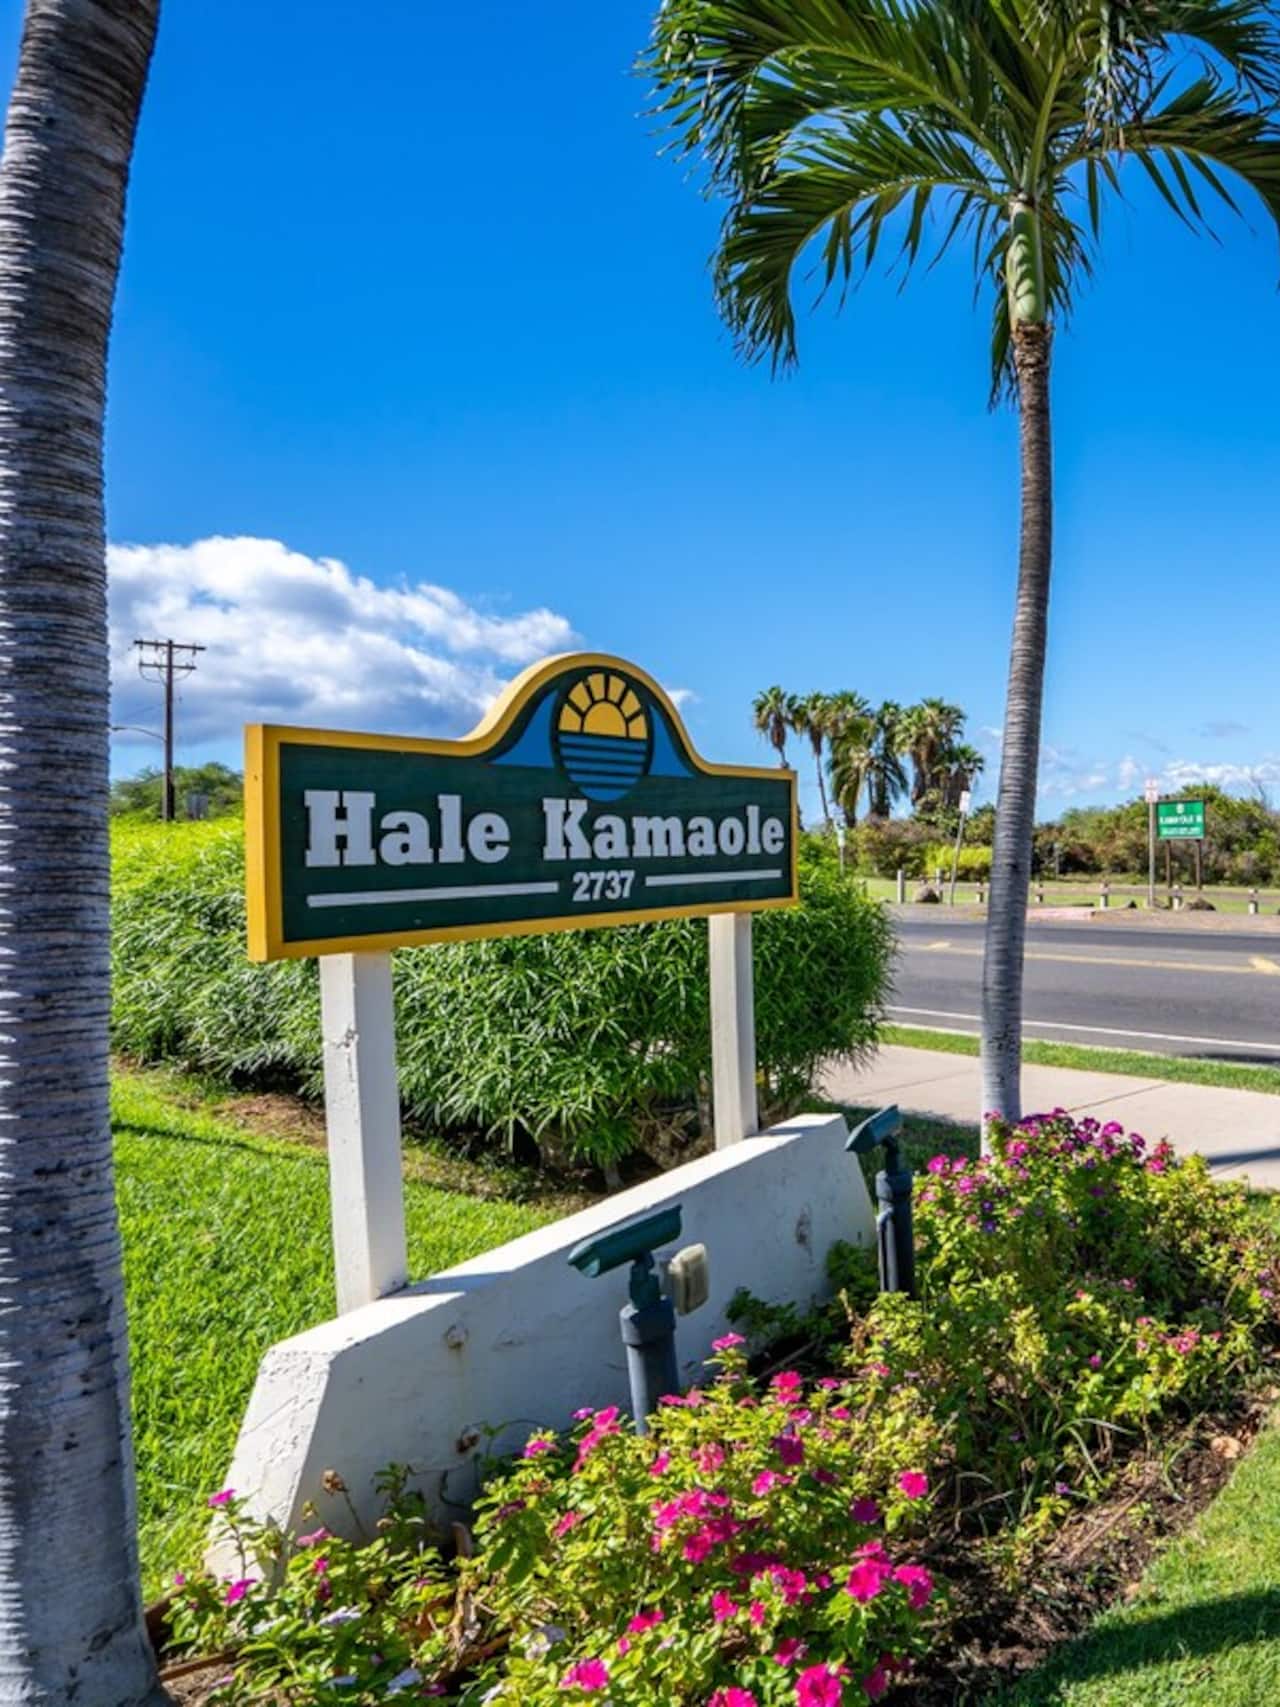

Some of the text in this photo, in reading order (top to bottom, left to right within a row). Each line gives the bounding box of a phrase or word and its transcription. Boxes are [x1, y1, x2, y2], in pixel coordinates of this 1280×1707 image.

[304, 789, 785, 867] Hale Kamaole
[572, 869, 635, 902] 2737
